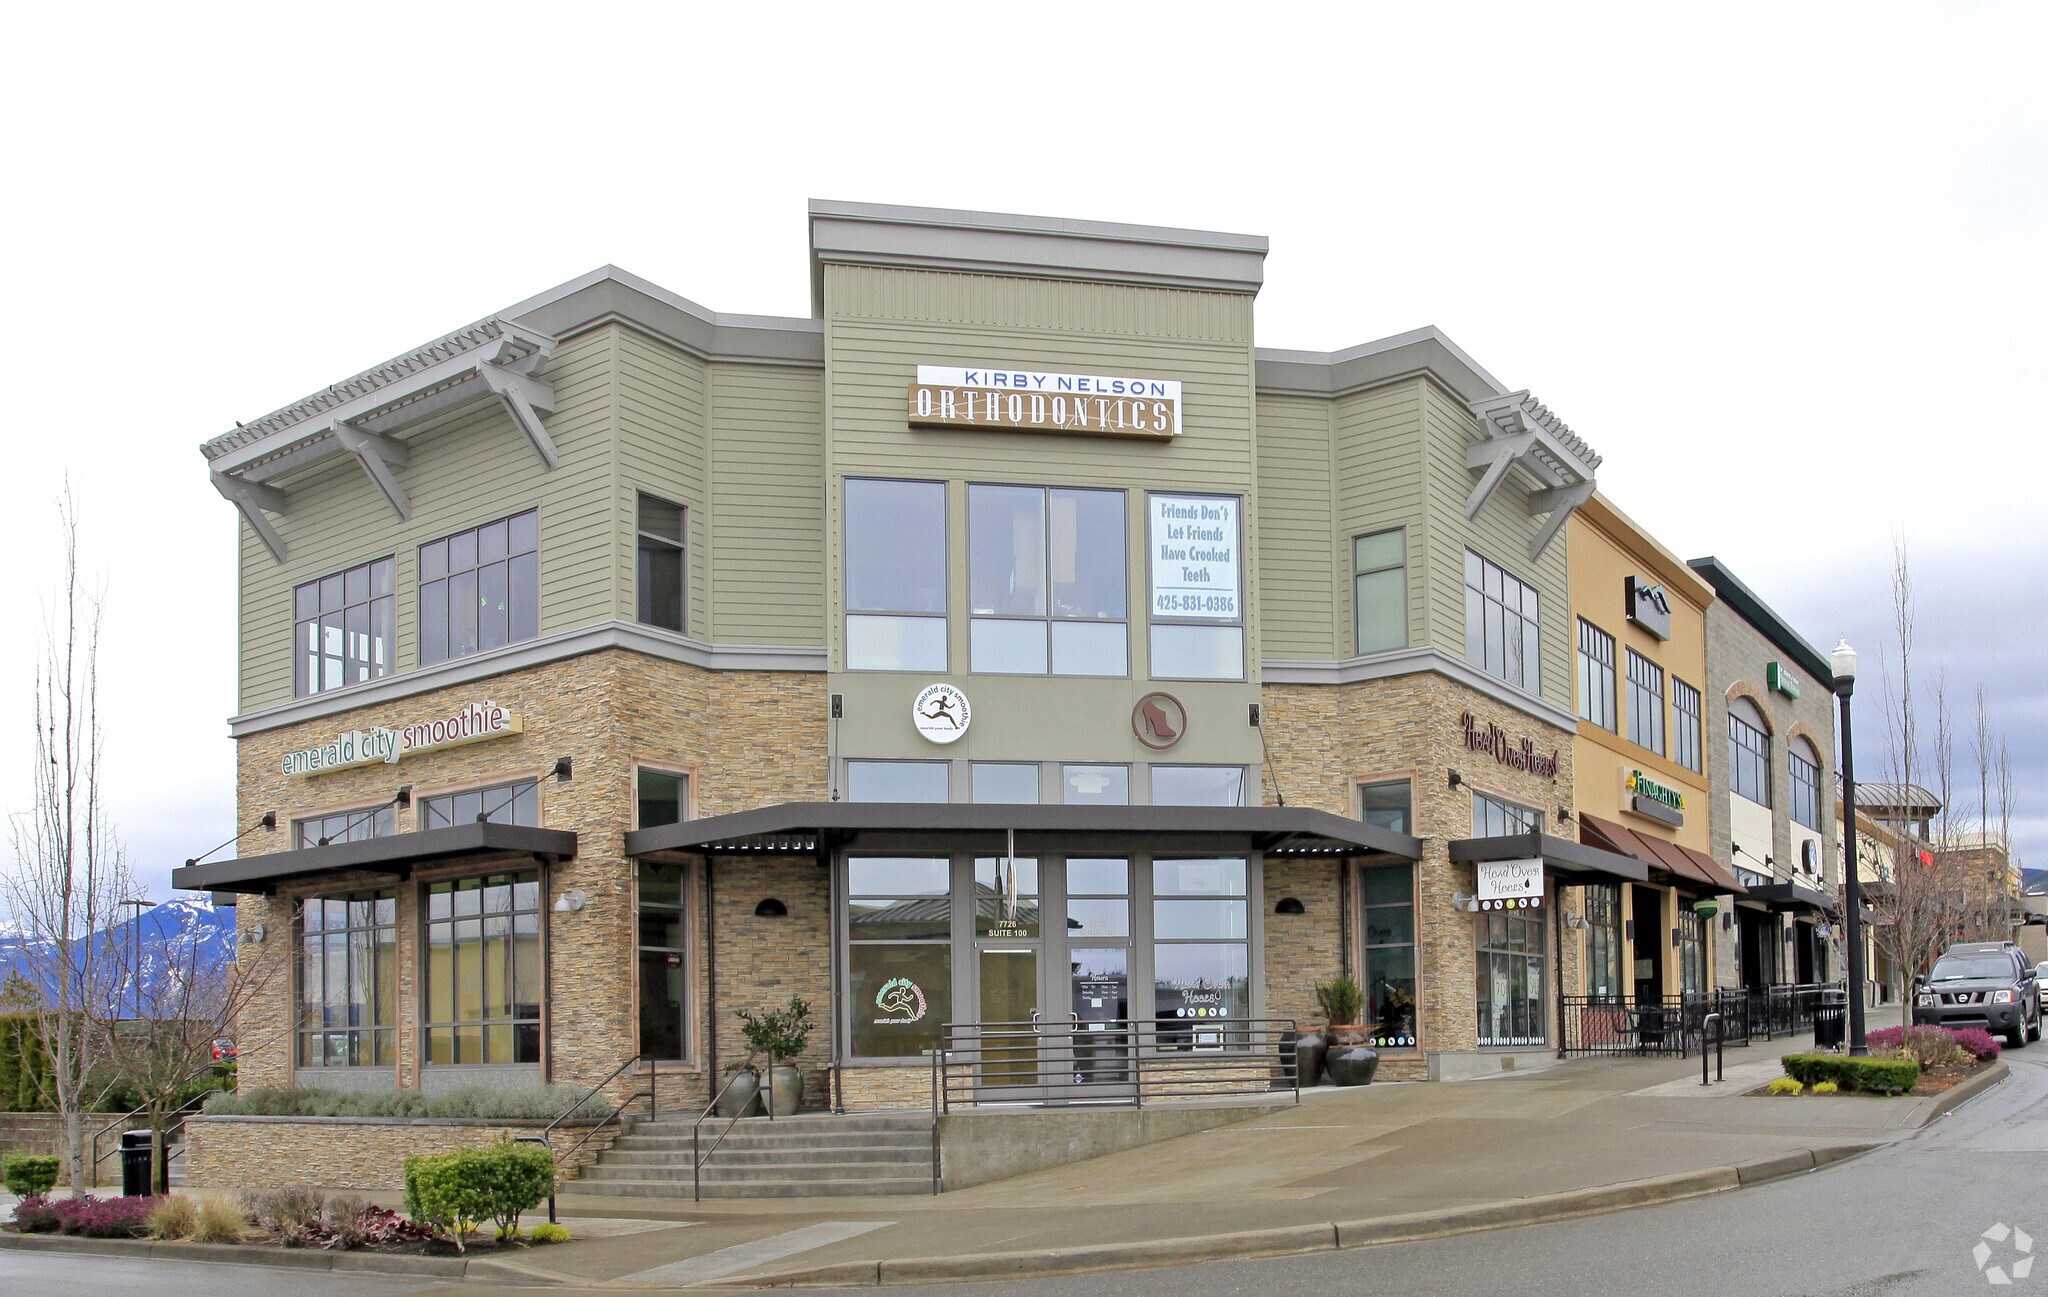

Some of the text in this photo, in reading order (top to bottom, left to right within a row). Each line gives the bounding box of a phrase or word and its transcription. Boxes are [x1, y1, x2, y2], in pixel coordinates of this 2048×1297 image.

[965, 371, 1165, 396] KIRBY NELSON
[917, 388, 1168, 430] ORTHODONTICS
[1161, 503, 1228, 520] Friends Don't
[1167, 524, 1223, 541] Let Friends
[1161, 545, 1230, 562] Have Crooked
[1182, 566, 1210, 582] Teeth
[1157, 594, 1234, 612] 425-831-0386
[917, 685, 969, 727] emerald city smoothie
[281, 700, 504, 776] emerald city smoothie
[998, 920, 1017, 928] 7726
[988, 929, 1028, 937] SUITE 100
[876, 978, 898, 1005] emerald
[898, 978, 913, 989] city
